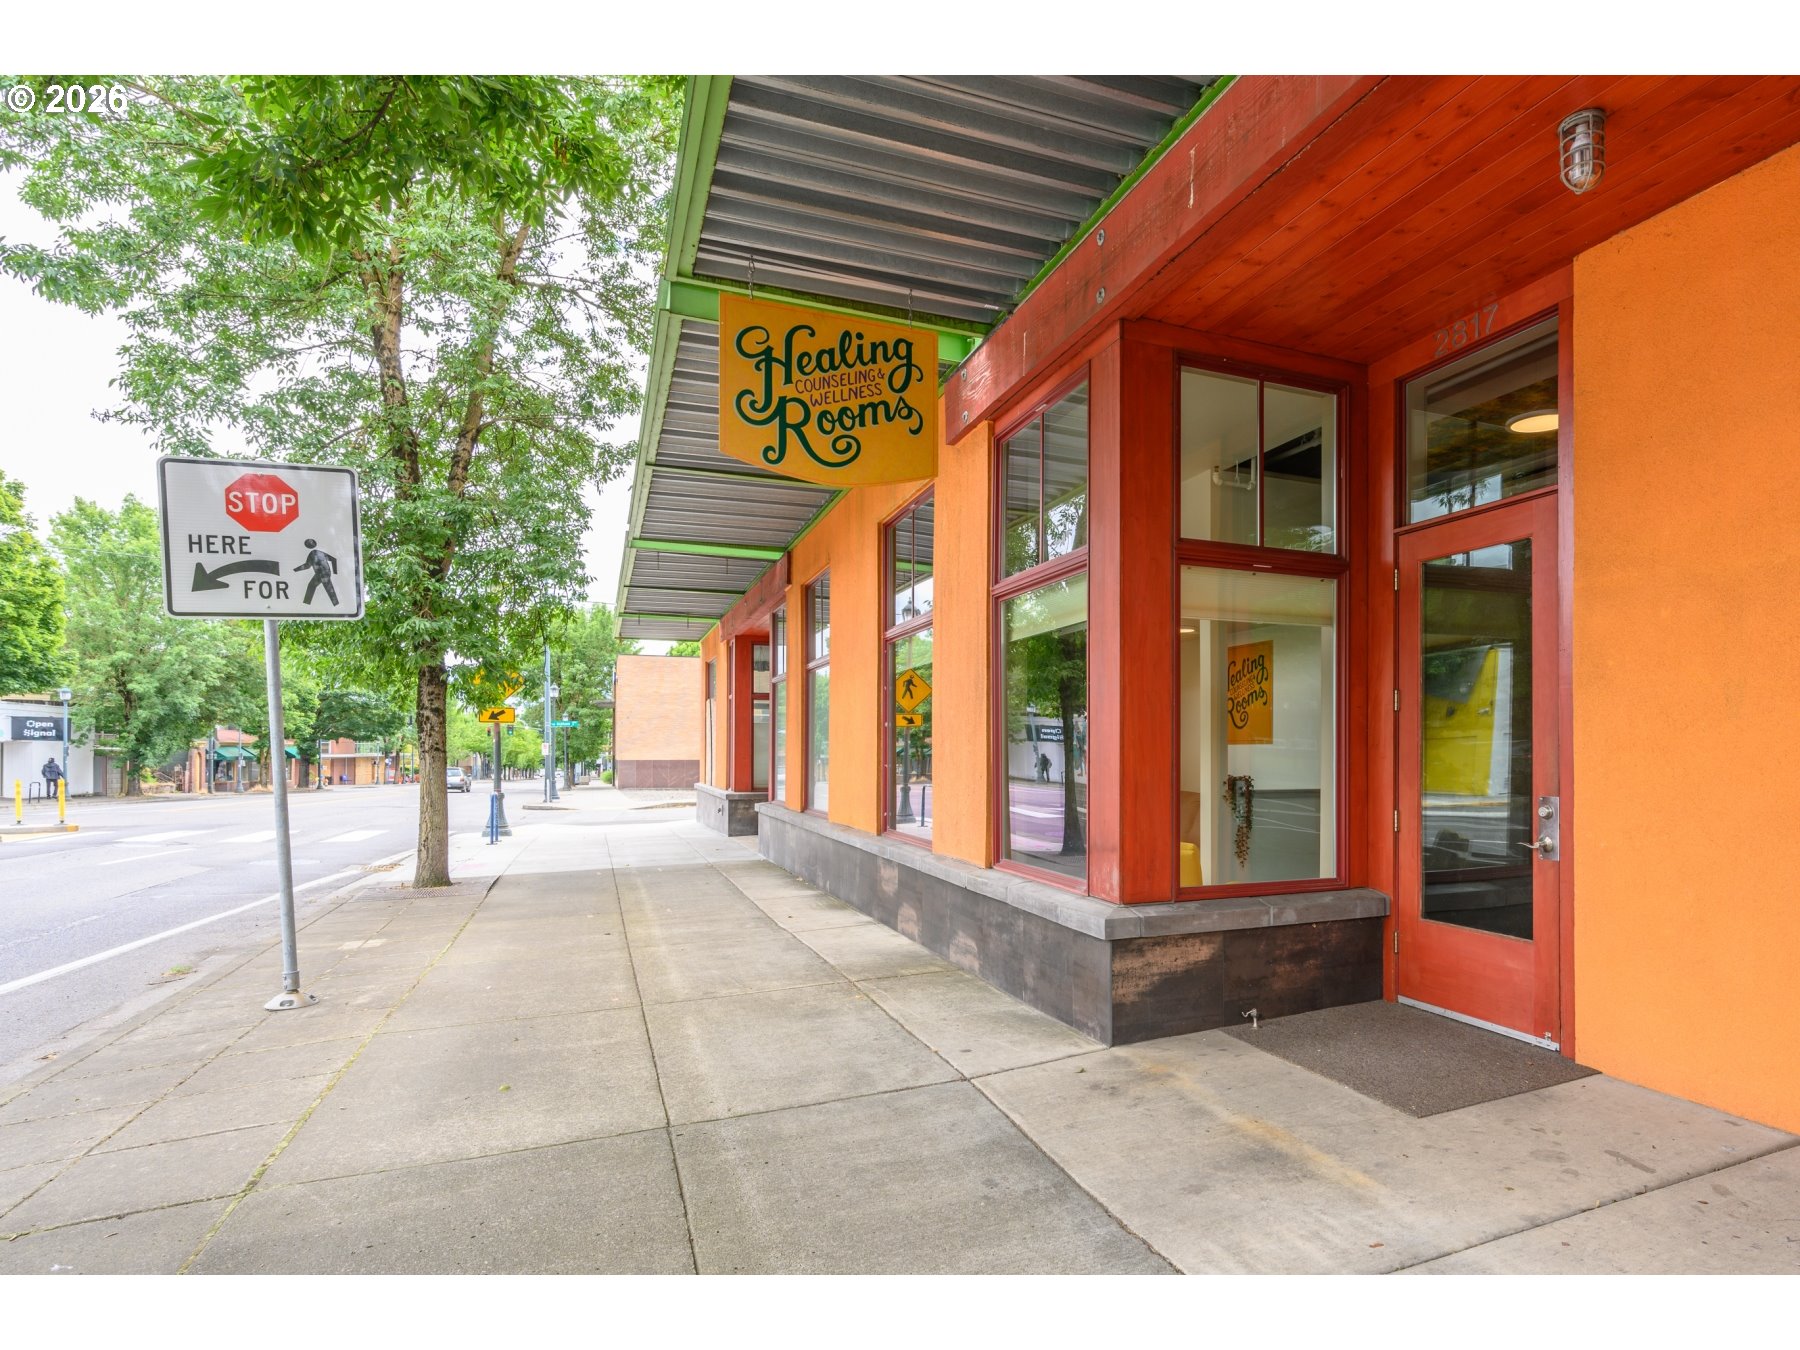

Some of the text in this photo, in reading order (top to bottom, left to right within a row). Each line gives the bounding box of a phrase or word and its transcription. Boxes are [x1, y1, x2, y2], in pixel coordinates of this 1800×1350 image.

[1434, 302, 1499, 358] 2817
[735, 324, 924, 414] Healing
[795, 369, 876, 394] COUNSELING
[809, 383, 883, 407] WELLNESS
[735, 389, 924, 468] Rooms
[228, 491, 297, 515] STOP
[188, 534, 252, 555] HERE
[243, 580, 290, 600] FOR
[23, 729, 56, 737] Signal
[26, 720, 54, 728] Open
